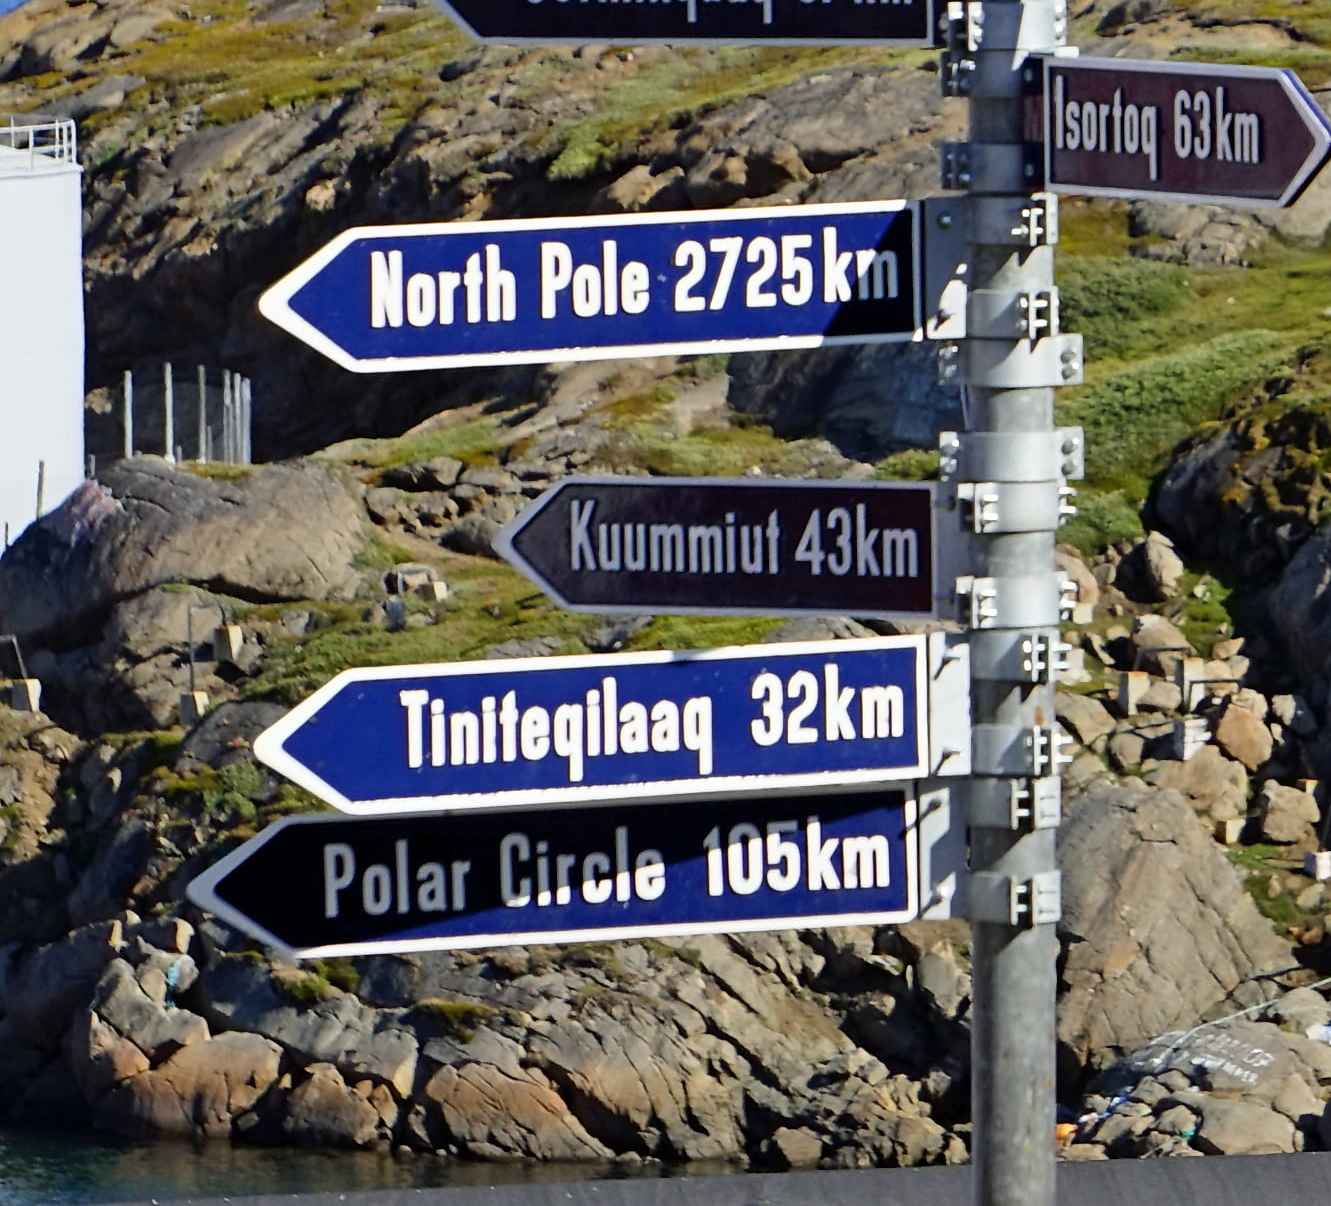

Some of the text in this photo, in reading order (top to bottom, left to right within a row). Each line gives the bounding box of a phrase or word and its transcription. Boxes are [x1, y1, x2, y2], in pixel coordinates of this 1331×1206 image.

[1054, 74, 1157, 182] Isortoq
[370, 243, 517, 329] North
[540, 239, 651, 320] Pole
[570, 499, 780, 575] Kuummiut
[400, 676, 713, 782] Tiniteqilaaq
[323, 839, 471, 918] Polar
[499, 826, 667, 908] Circle
